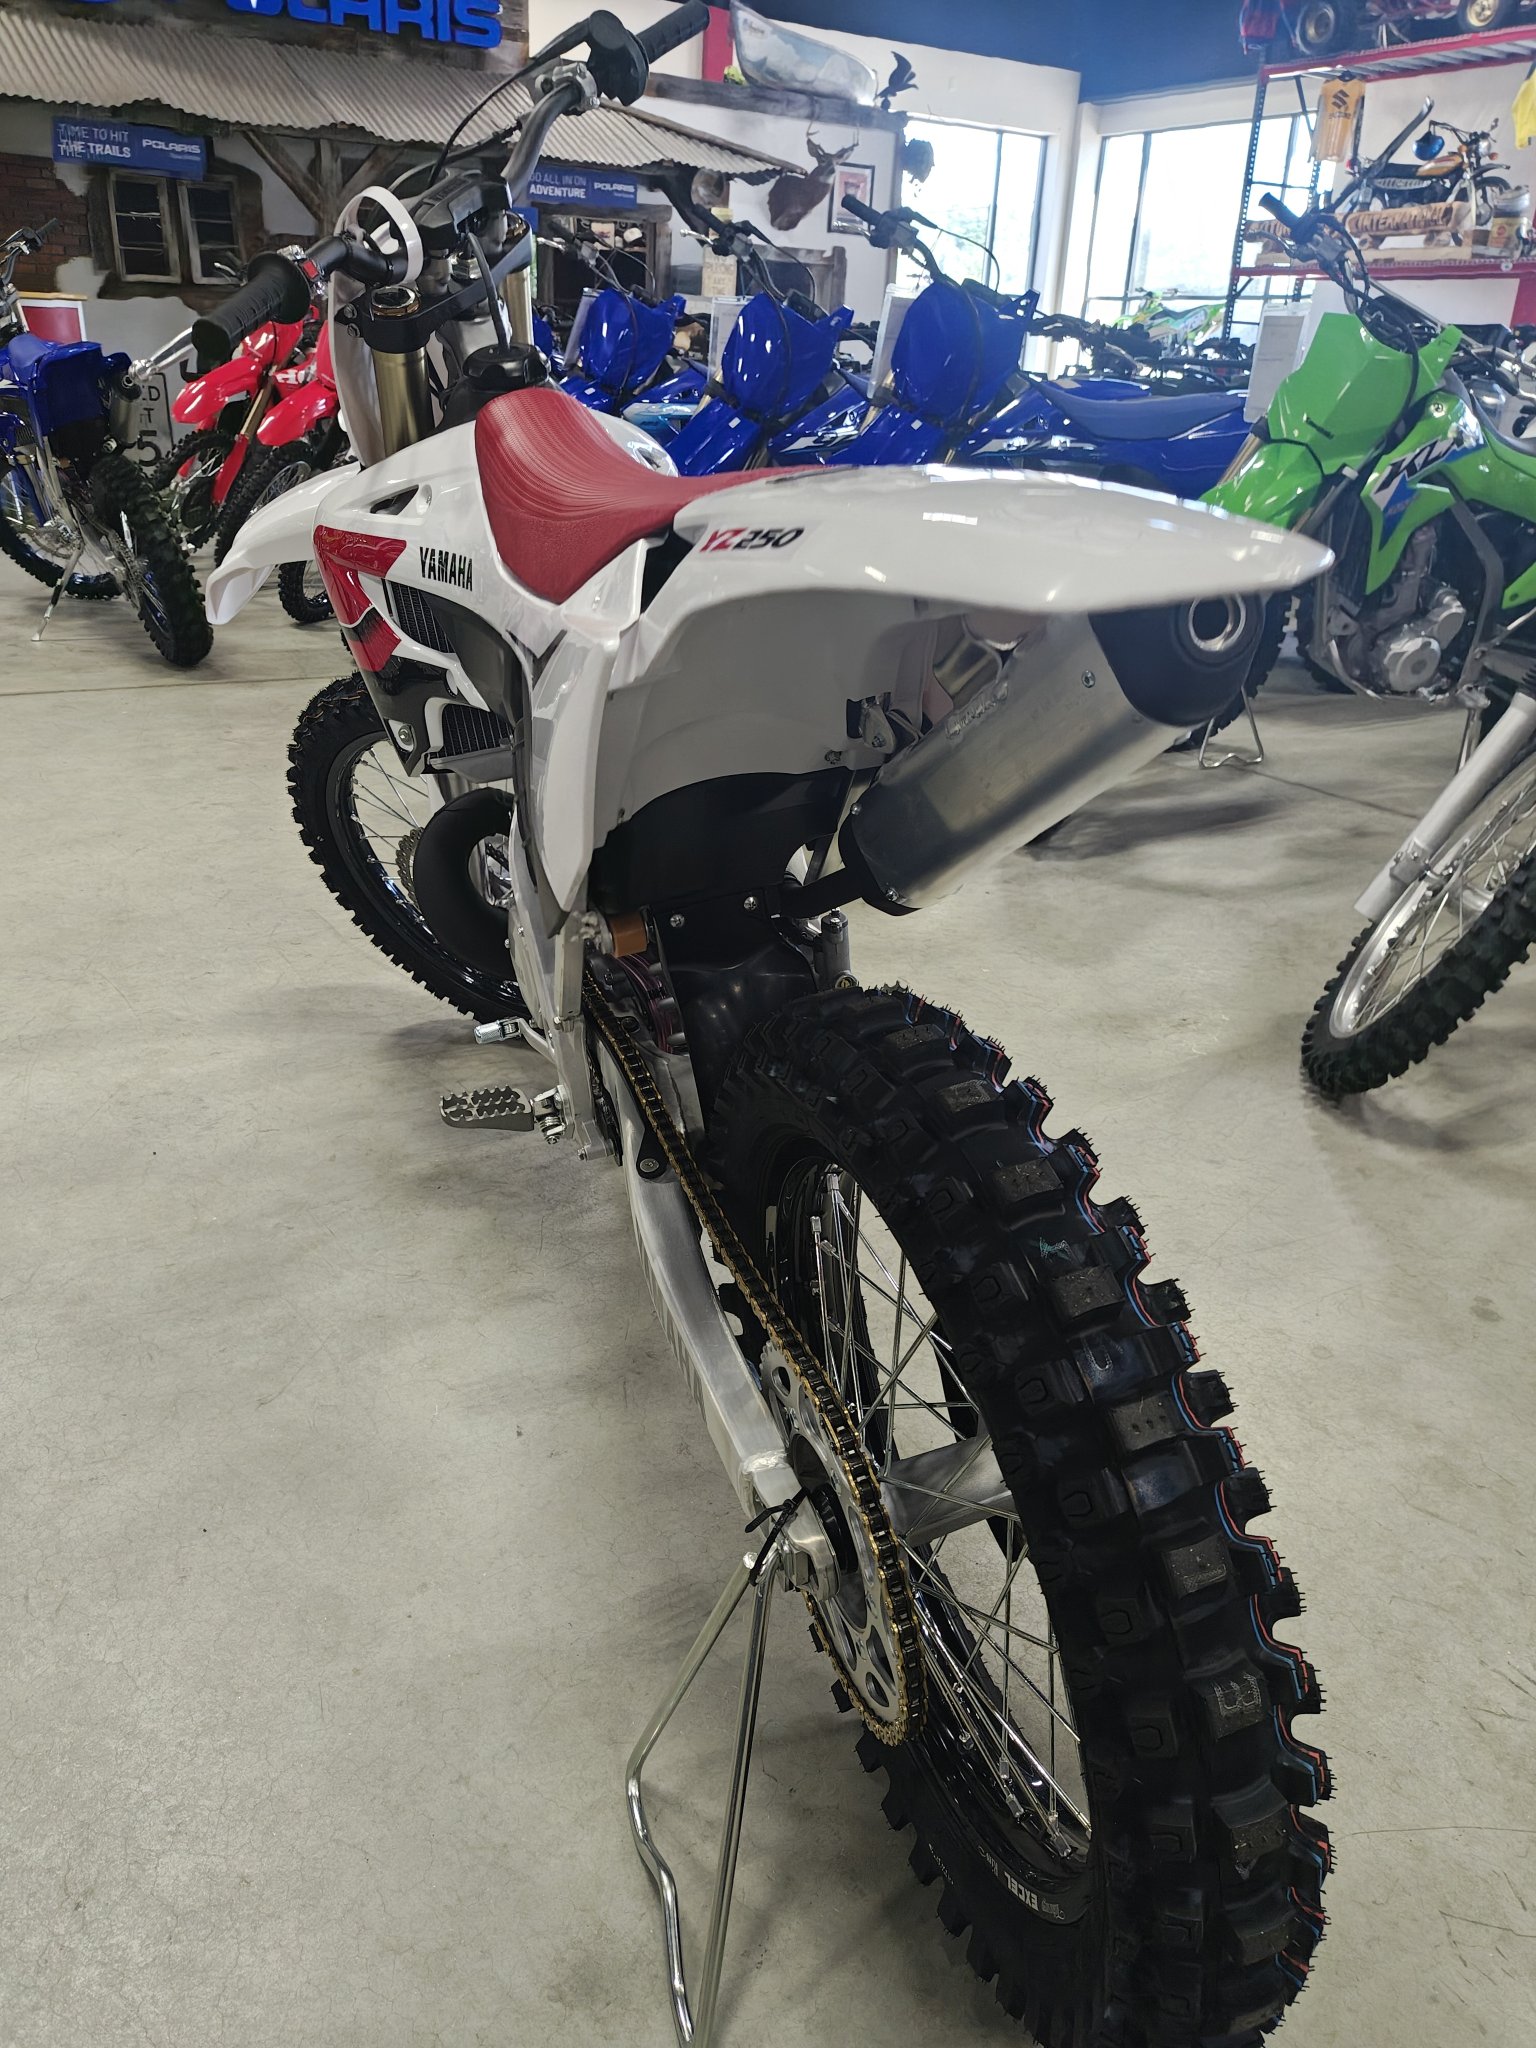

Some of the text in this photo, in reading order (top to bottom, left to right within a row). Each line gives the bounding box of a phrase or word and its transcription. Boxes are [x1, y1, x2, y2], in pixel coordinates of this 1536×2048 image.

[94, 128, 107, 140] TO
[110, 131, 128, 143] HIT
[88, 142, 131, 158] TRAILS
[142, 138, 201, 154] POLARIS
[543, 173, 559, 184] ALL
[529, 184, 586, 199] ADVENTURE
[593, 182, 635, 193] POLARIS
[699, 526, 806, 553] YZ250
[419, 546, 474, 592] YAMAHA
[1004, 1871, 1040, 1912] EXCEL
